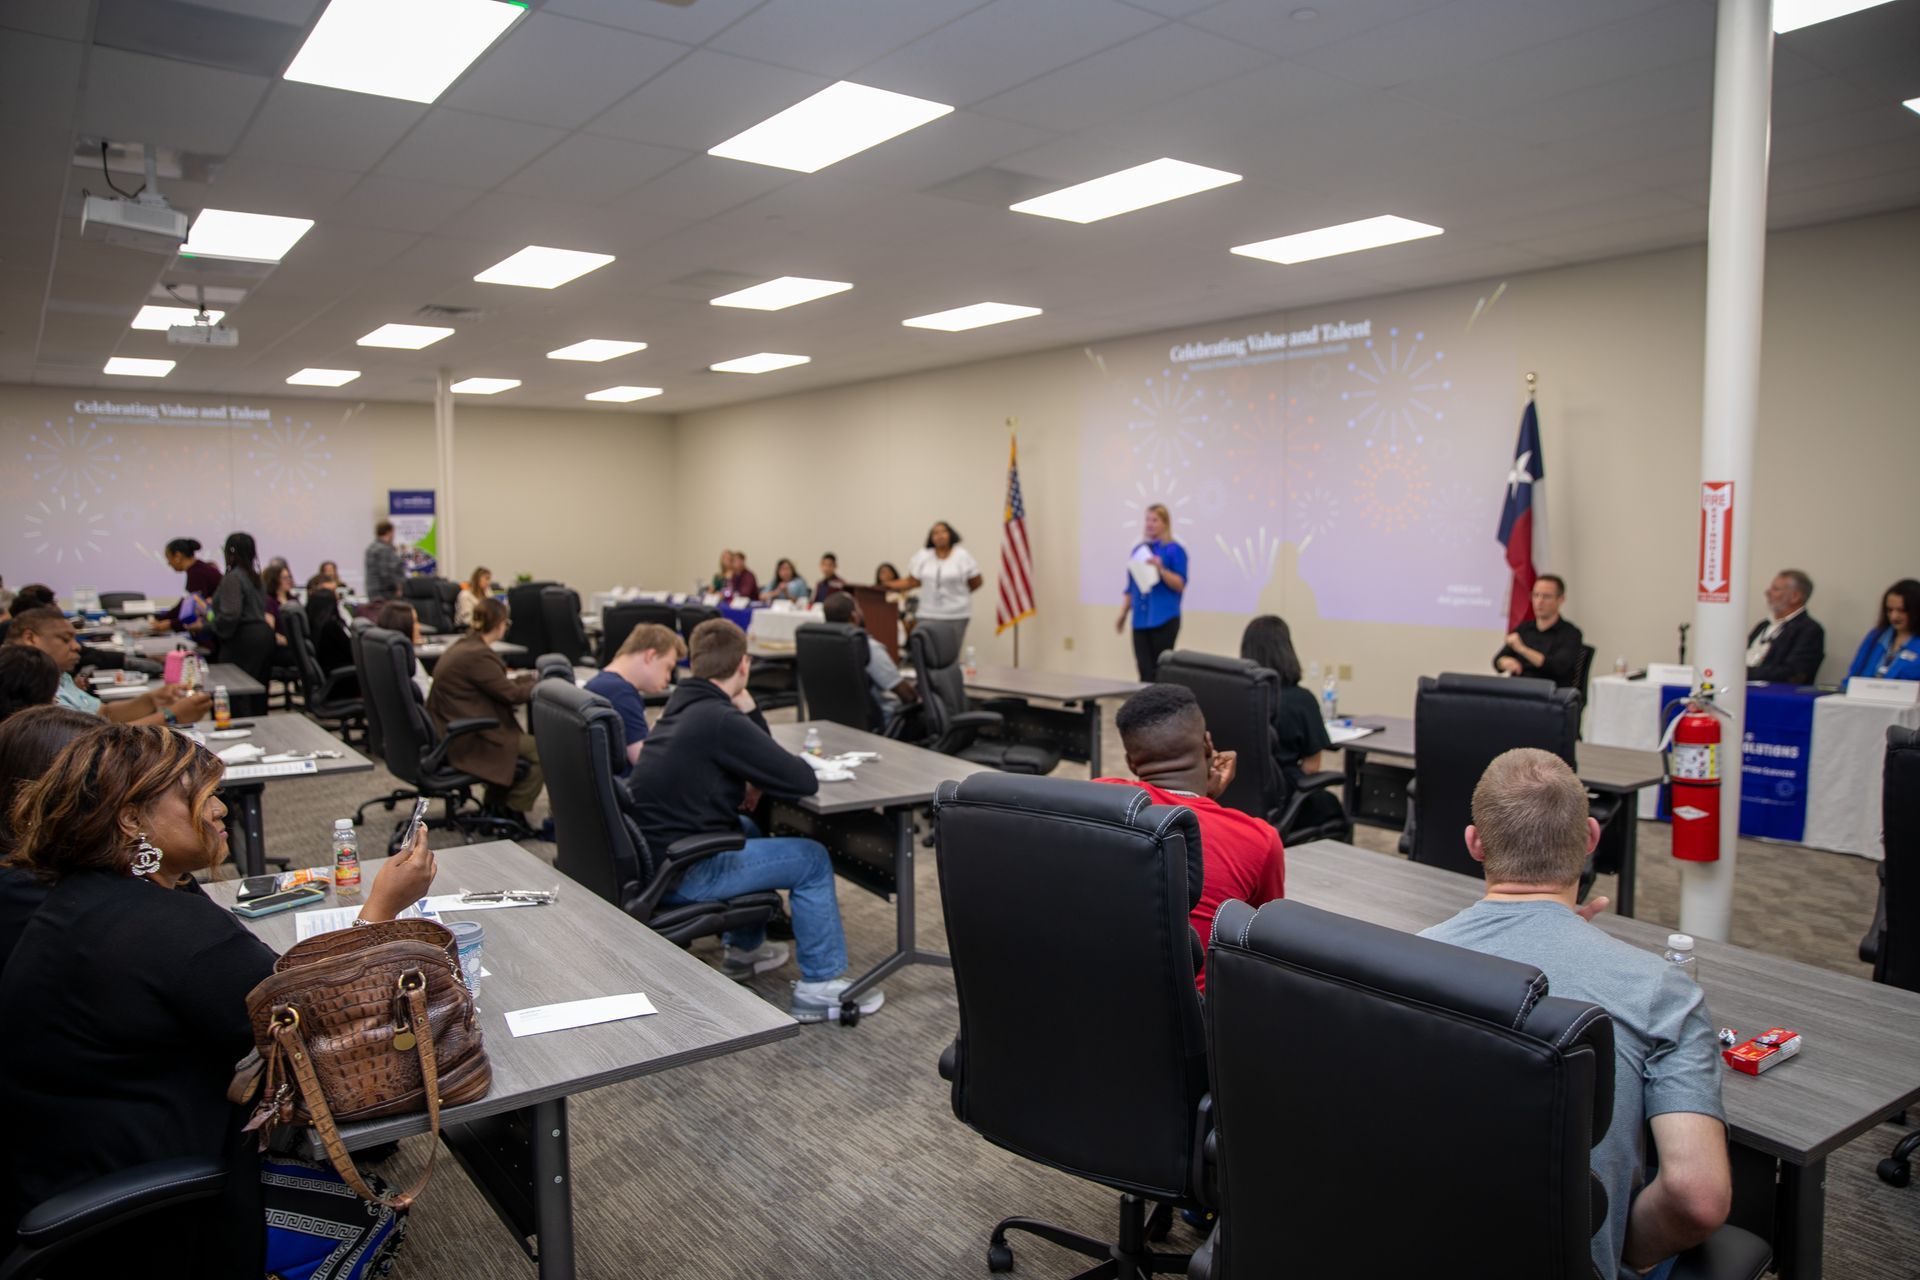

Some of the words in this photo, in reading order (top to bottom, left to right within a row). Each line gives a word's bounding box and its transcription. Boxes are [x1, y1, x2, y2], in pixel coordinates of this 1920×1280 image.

[1170, 337, 1247, 363] Celebrating
[1248, 330, 1286, 352] Value
[1288, 324, 1318, 346] and
[1320, 319, 1371, 342] Talent
[74, 400, 159, 418] Celebrating
[160, 403, 199, 417] Value
[200, 405, 227, 418] and
[228, 406, 271, 420] Talent
[1704, 495, 1725, 506] FIRE
[1743, 741, 1800, 759] OLUTIONS
